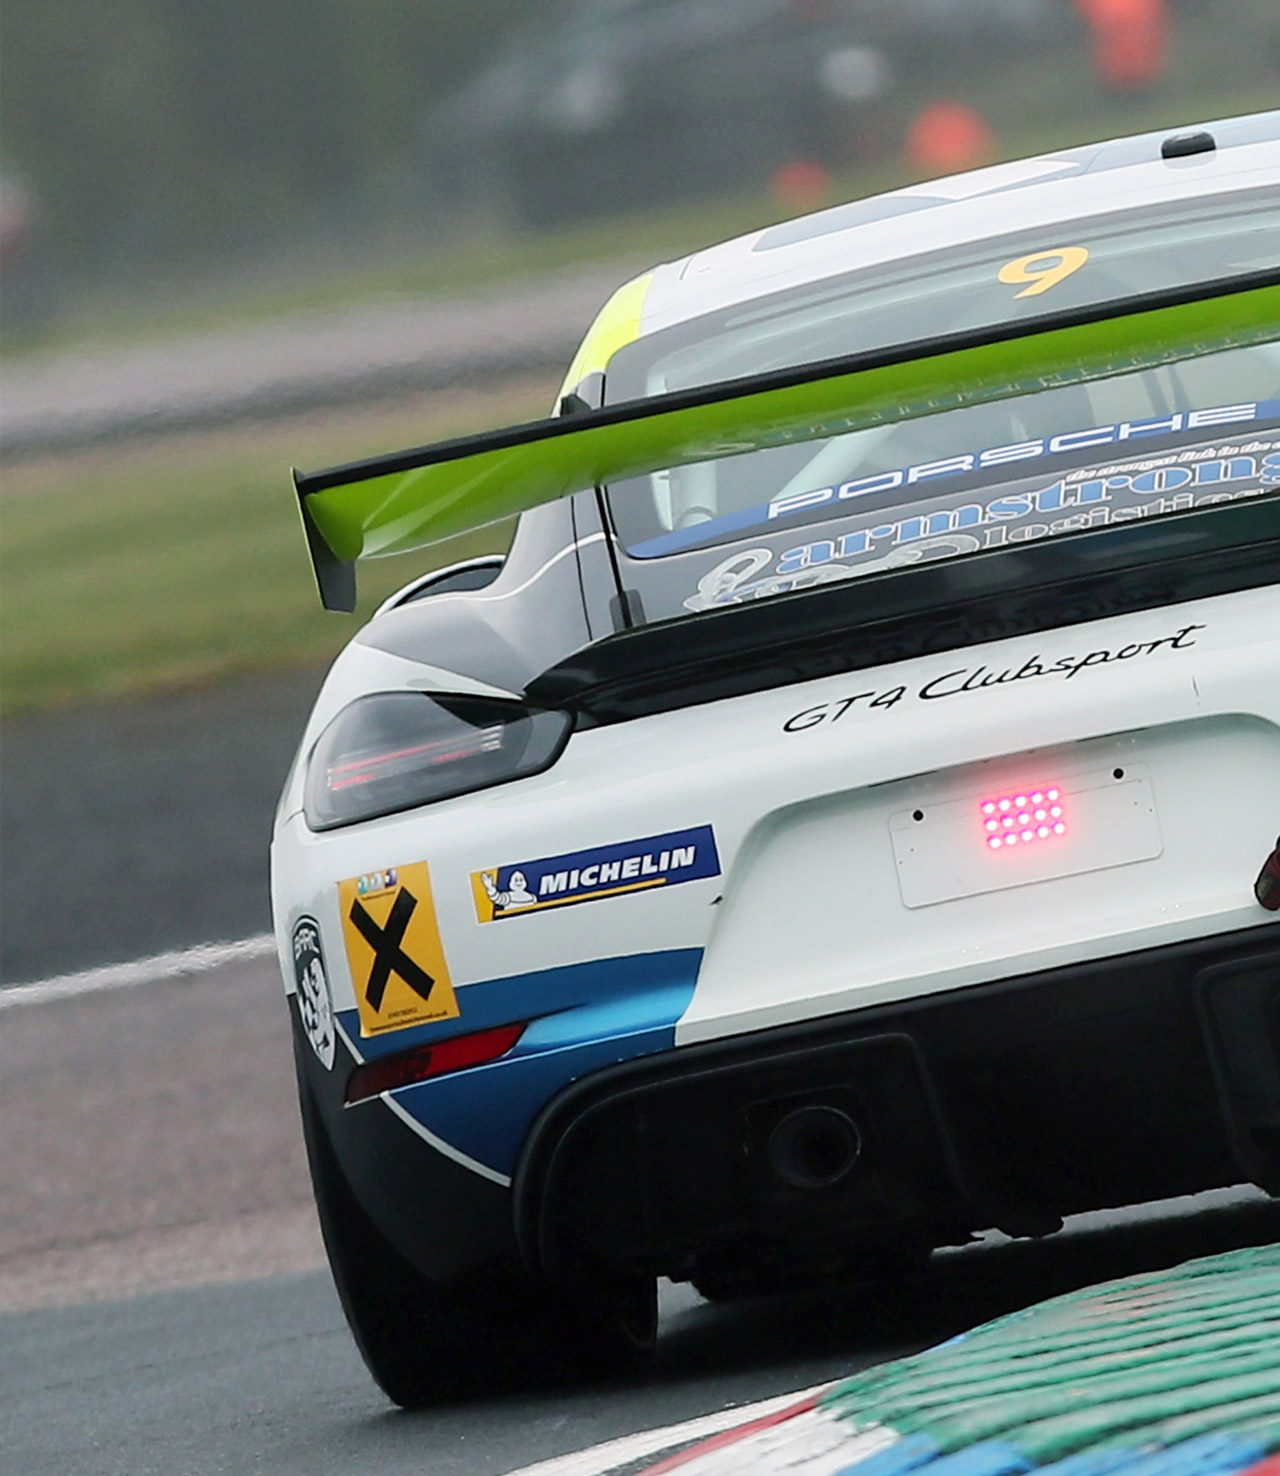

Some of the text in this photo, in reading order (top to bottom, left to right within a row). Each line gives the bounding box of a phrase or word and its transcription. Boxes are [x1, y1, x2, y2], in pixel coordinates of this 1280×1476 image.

[997, 246, 1088, 300] 9
[767, 402, 1257, 519] PORSCHE
[782, 623, 1207, 733] GT4 Clubsport
[539, 845, 696, 896] MICHELIN
